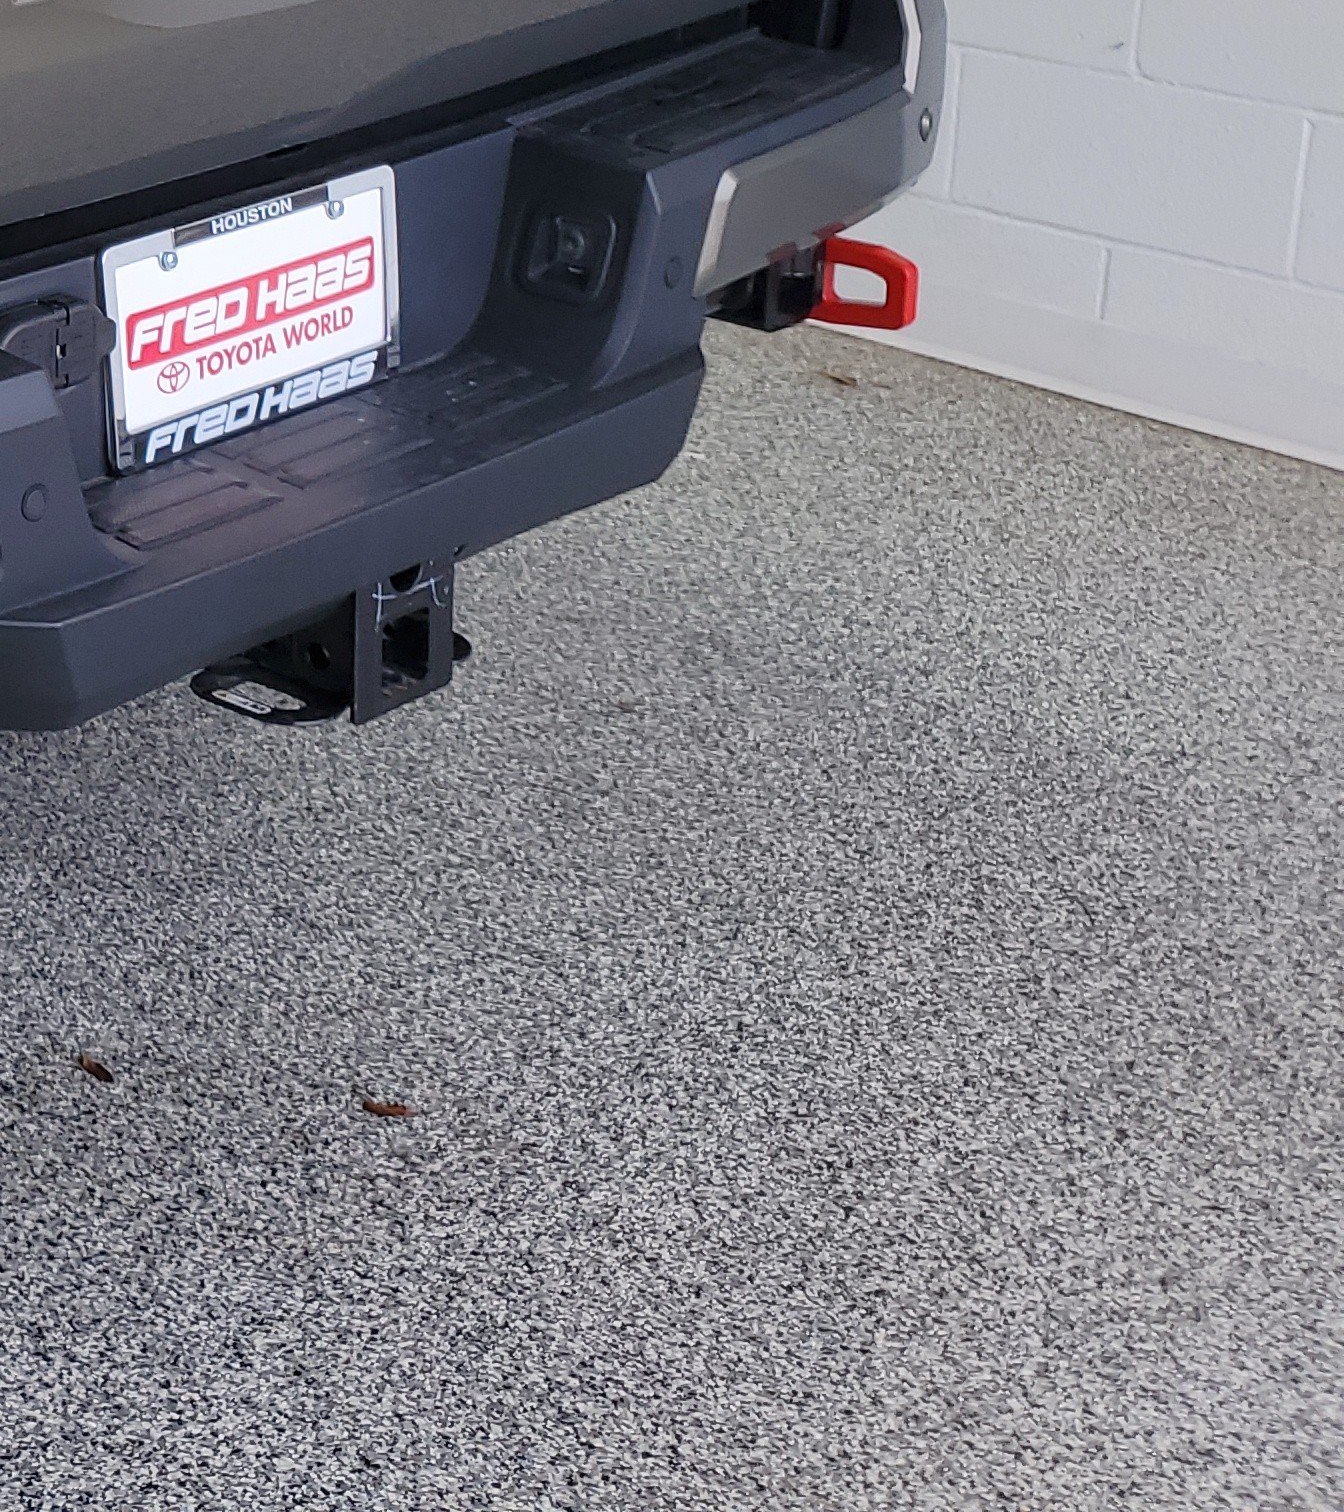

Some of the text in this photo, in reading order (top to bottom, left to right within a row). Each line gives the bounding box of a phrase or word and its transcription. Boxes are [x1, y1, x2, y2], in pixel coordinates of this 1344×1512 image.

[211, 197, 293, 235] HOUSTON
[195, 305, 354, 381] TOYOTA WORLD
